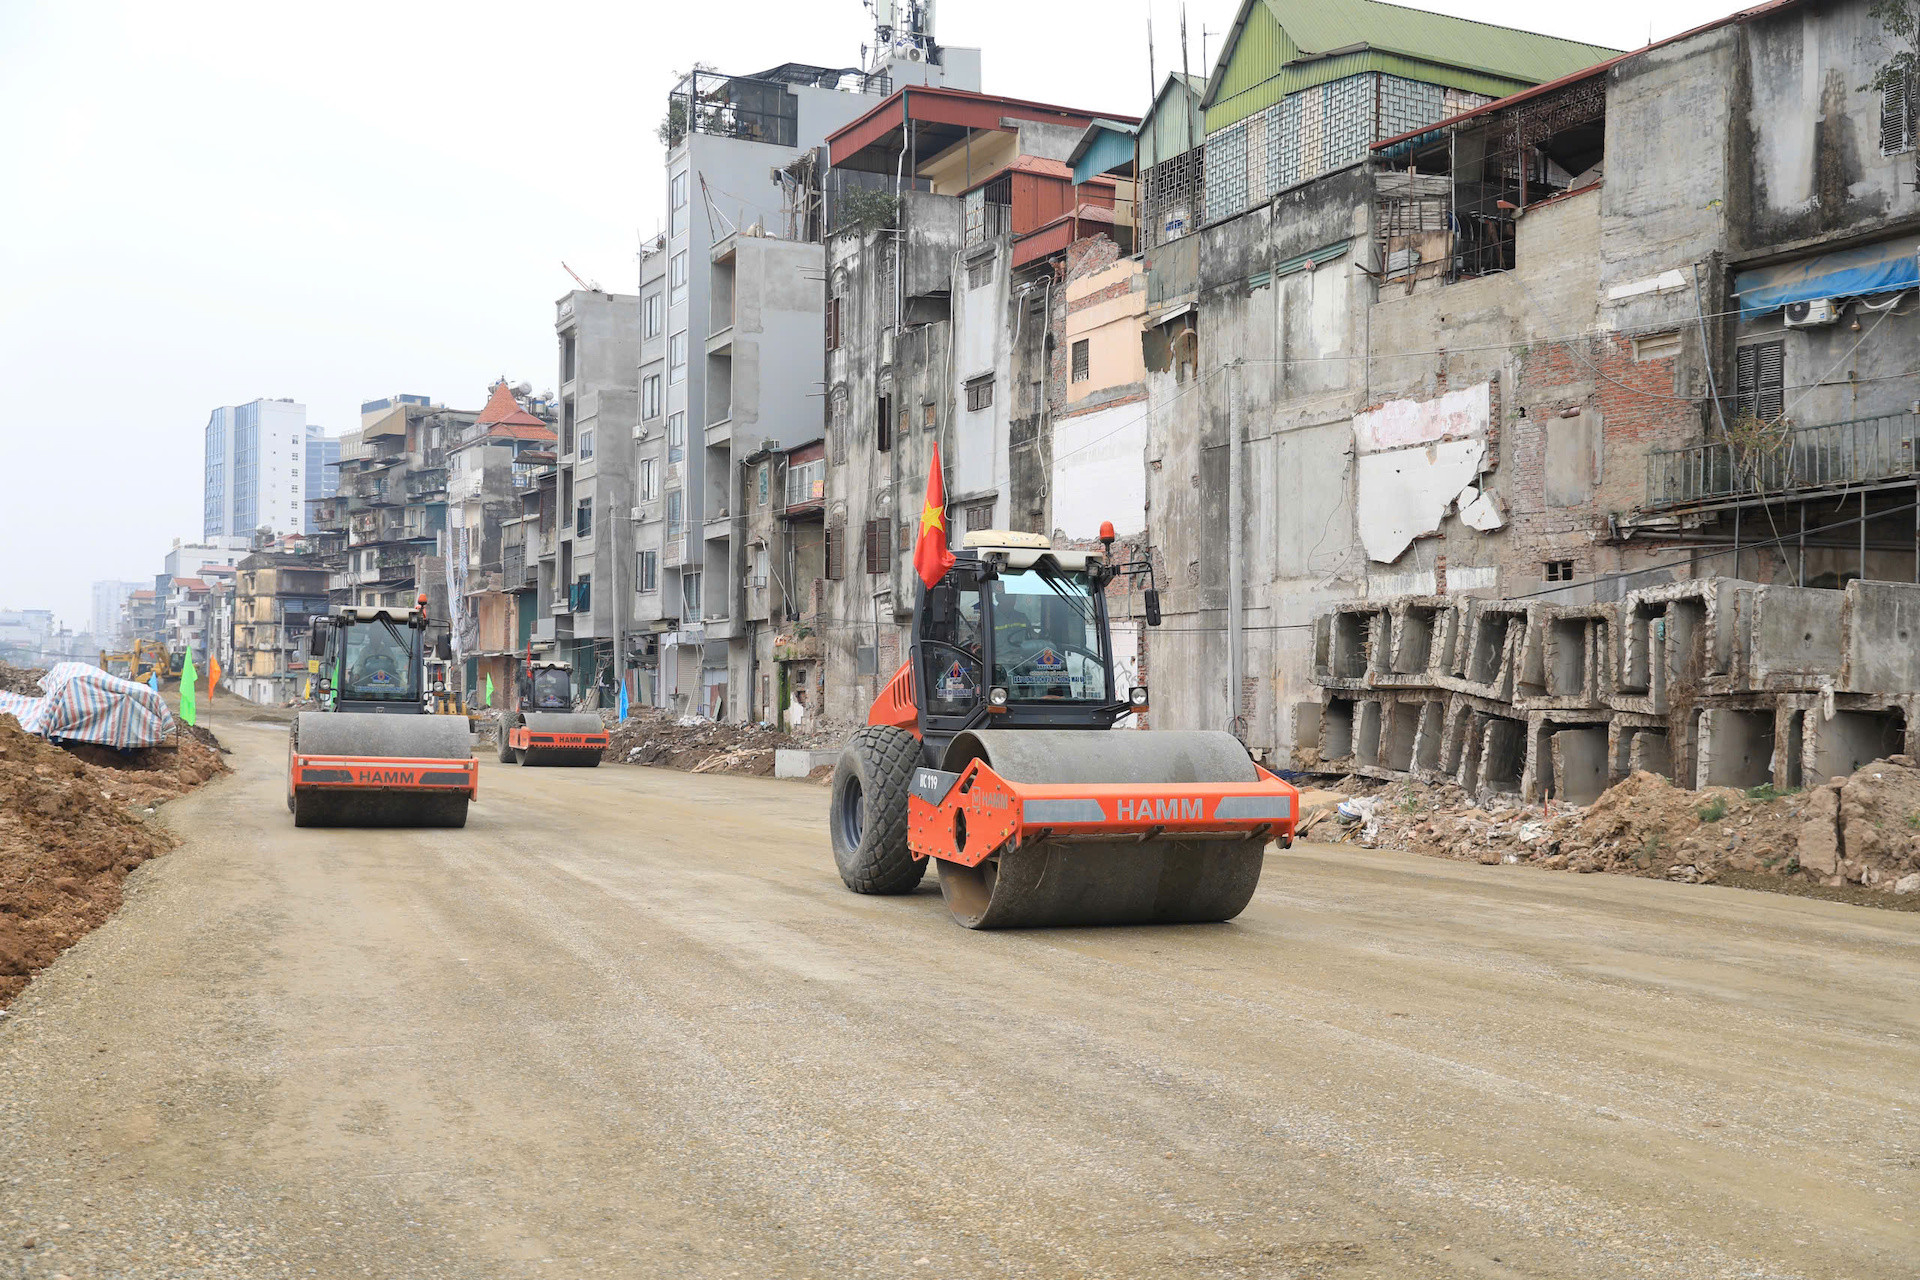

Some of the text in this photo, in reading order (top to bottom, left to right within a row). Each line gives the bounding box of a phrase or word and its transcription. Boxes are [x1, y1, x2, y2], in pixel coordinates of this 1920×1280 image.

[359, 771, 414, 784] HAMM
[982, 791, 1008, 809] HAMM
[1117, 798, 1203, 820] HAMM
